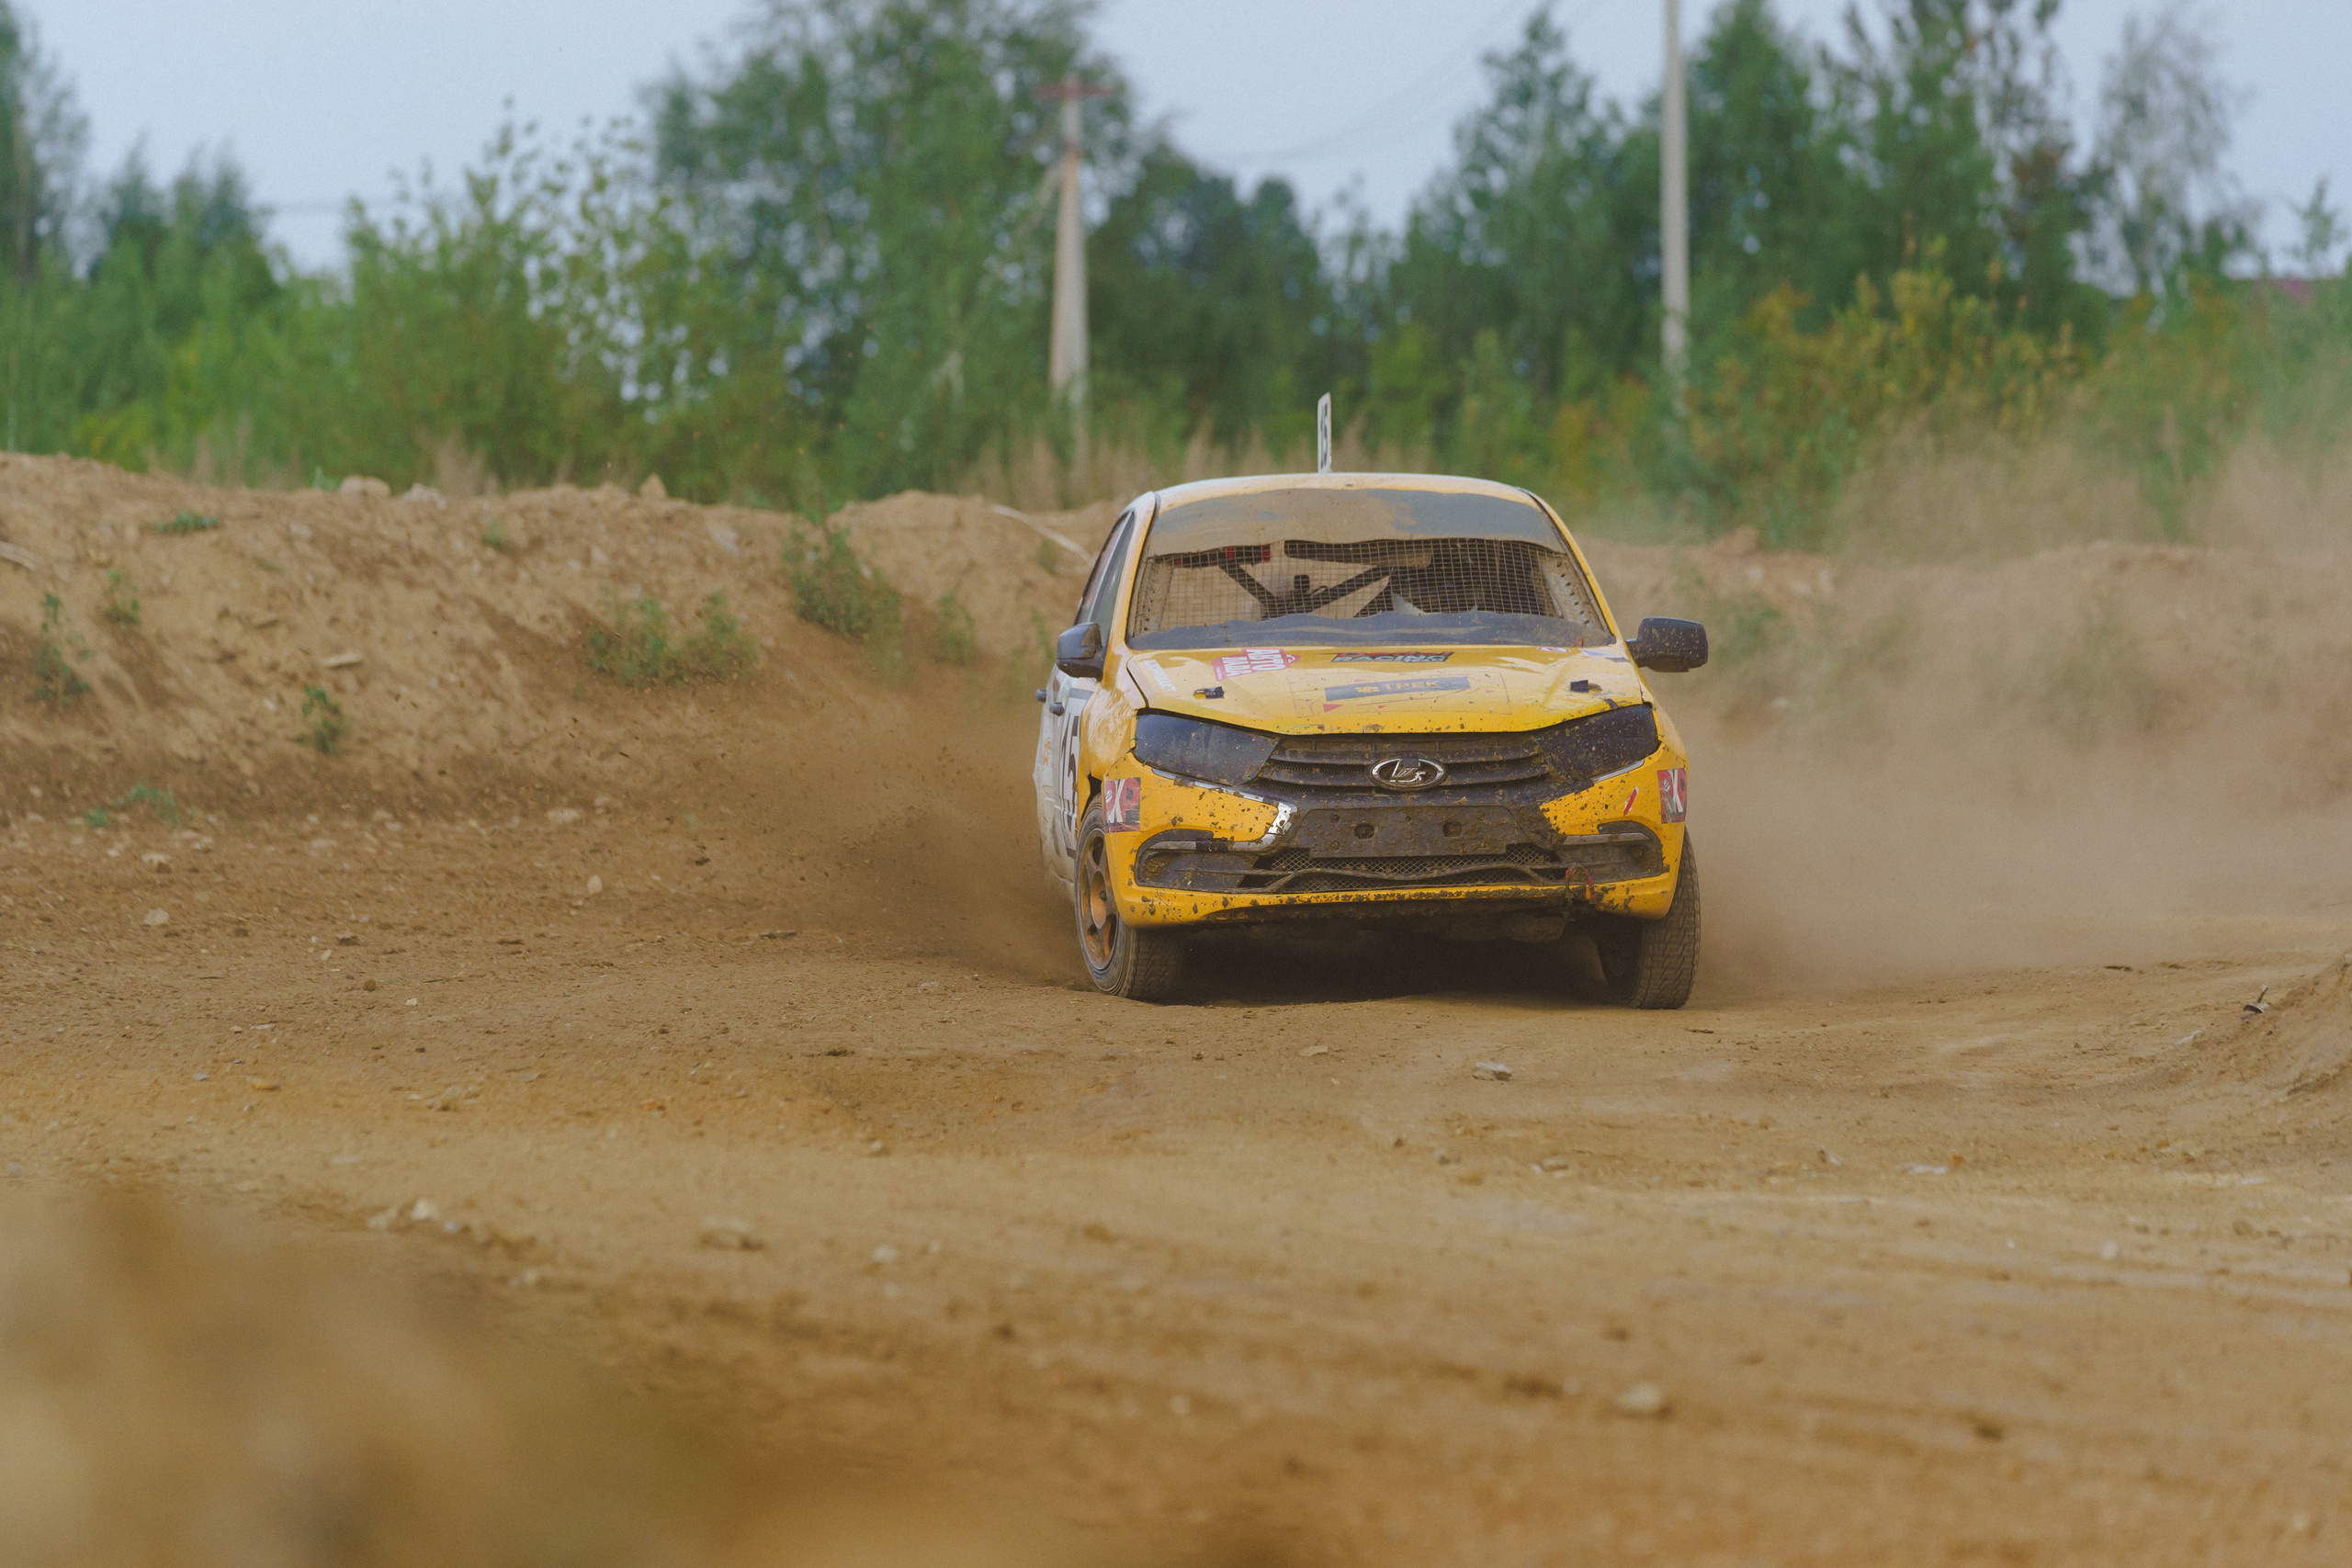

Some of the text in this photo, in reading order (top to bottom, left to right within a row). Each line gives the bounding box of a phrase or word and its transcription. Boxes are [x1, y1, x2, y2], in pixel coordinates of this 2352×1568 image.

[1247, 649, 1287, 671] АВТО
[1333, 655, 1447, 663] RACING
[1381, 680, 1441, 691] ТРЕК
[1061, 712, 1080, 831] 15
